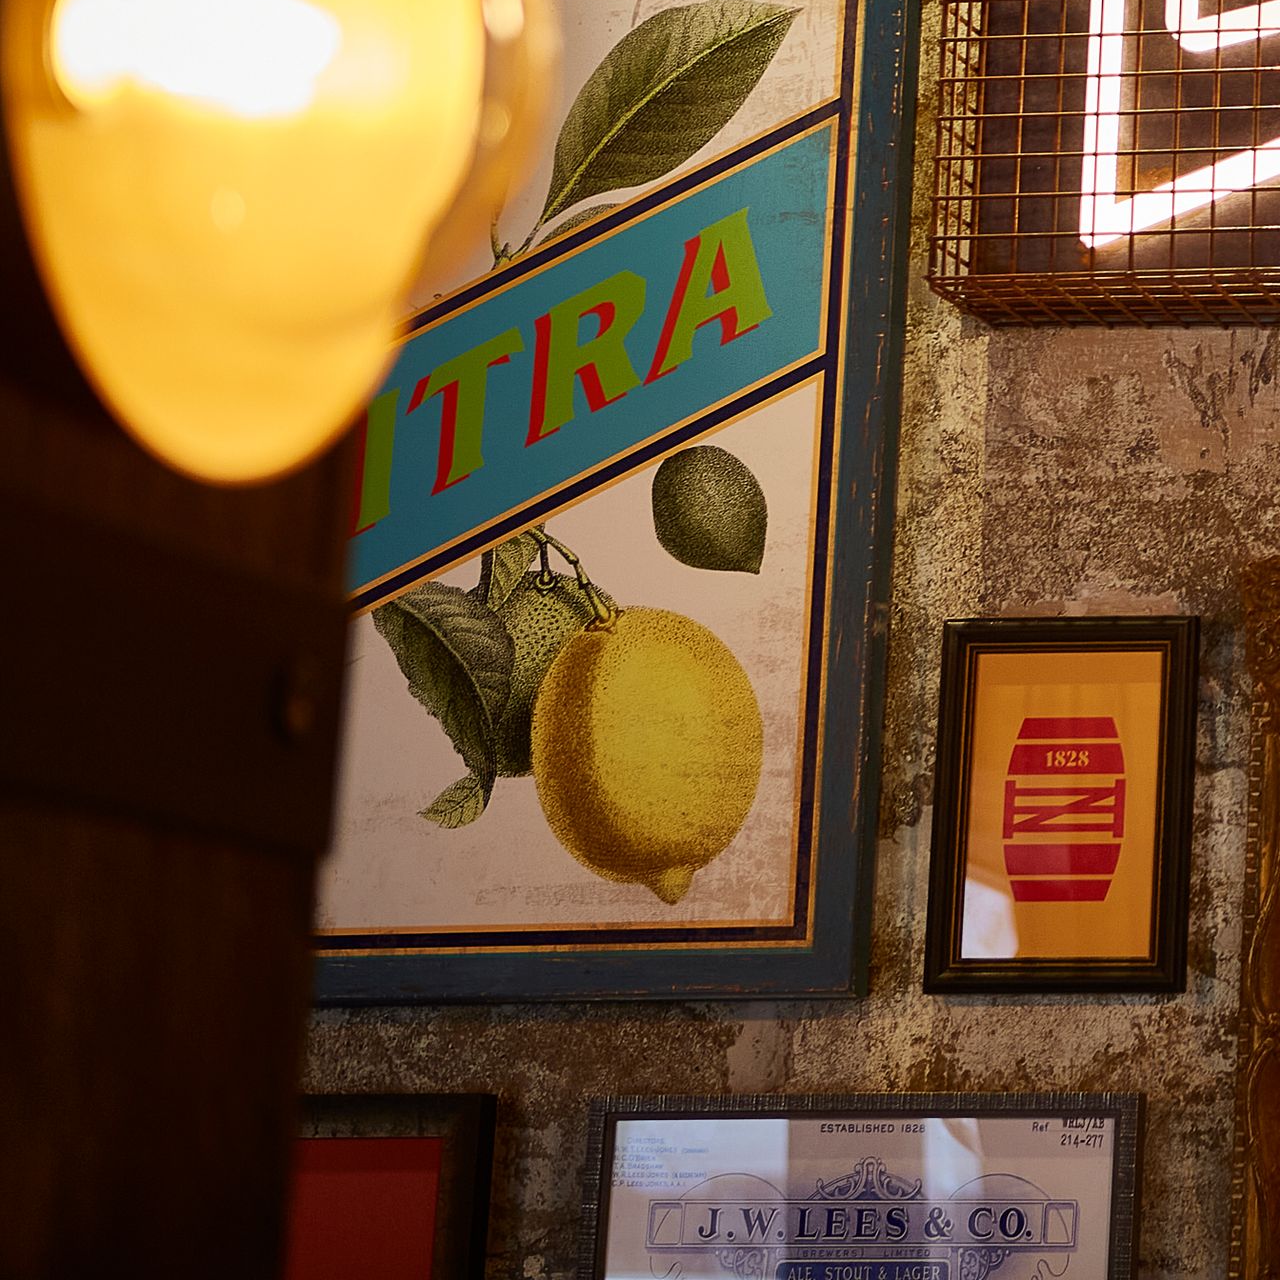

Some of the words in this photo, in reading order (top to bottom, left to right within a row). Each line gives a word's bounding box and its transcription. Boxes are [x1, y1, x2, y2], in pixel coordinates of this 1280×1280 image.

[1046, 750, 1090, 767] 1828
[820, 1123, 895, 1134] ESTABLISHED
[901, 1122, 926, 1133] 1828
[1032, 1121, 1050, 1132] Ref
[1061, 1133, 1104, 1148] 214-277
[795, 1206, 909, 1241] LEES
[924, 1206, 954, 1240] &
[968, 1206, 1034, 1240] CO.
[883, 1248, 931, 1258] LIMITED
[825, 1266, 872, 1280] STOUT
[879, 1266, 888, 1280] &
[896, 1266, 941, 1280] LAGER
